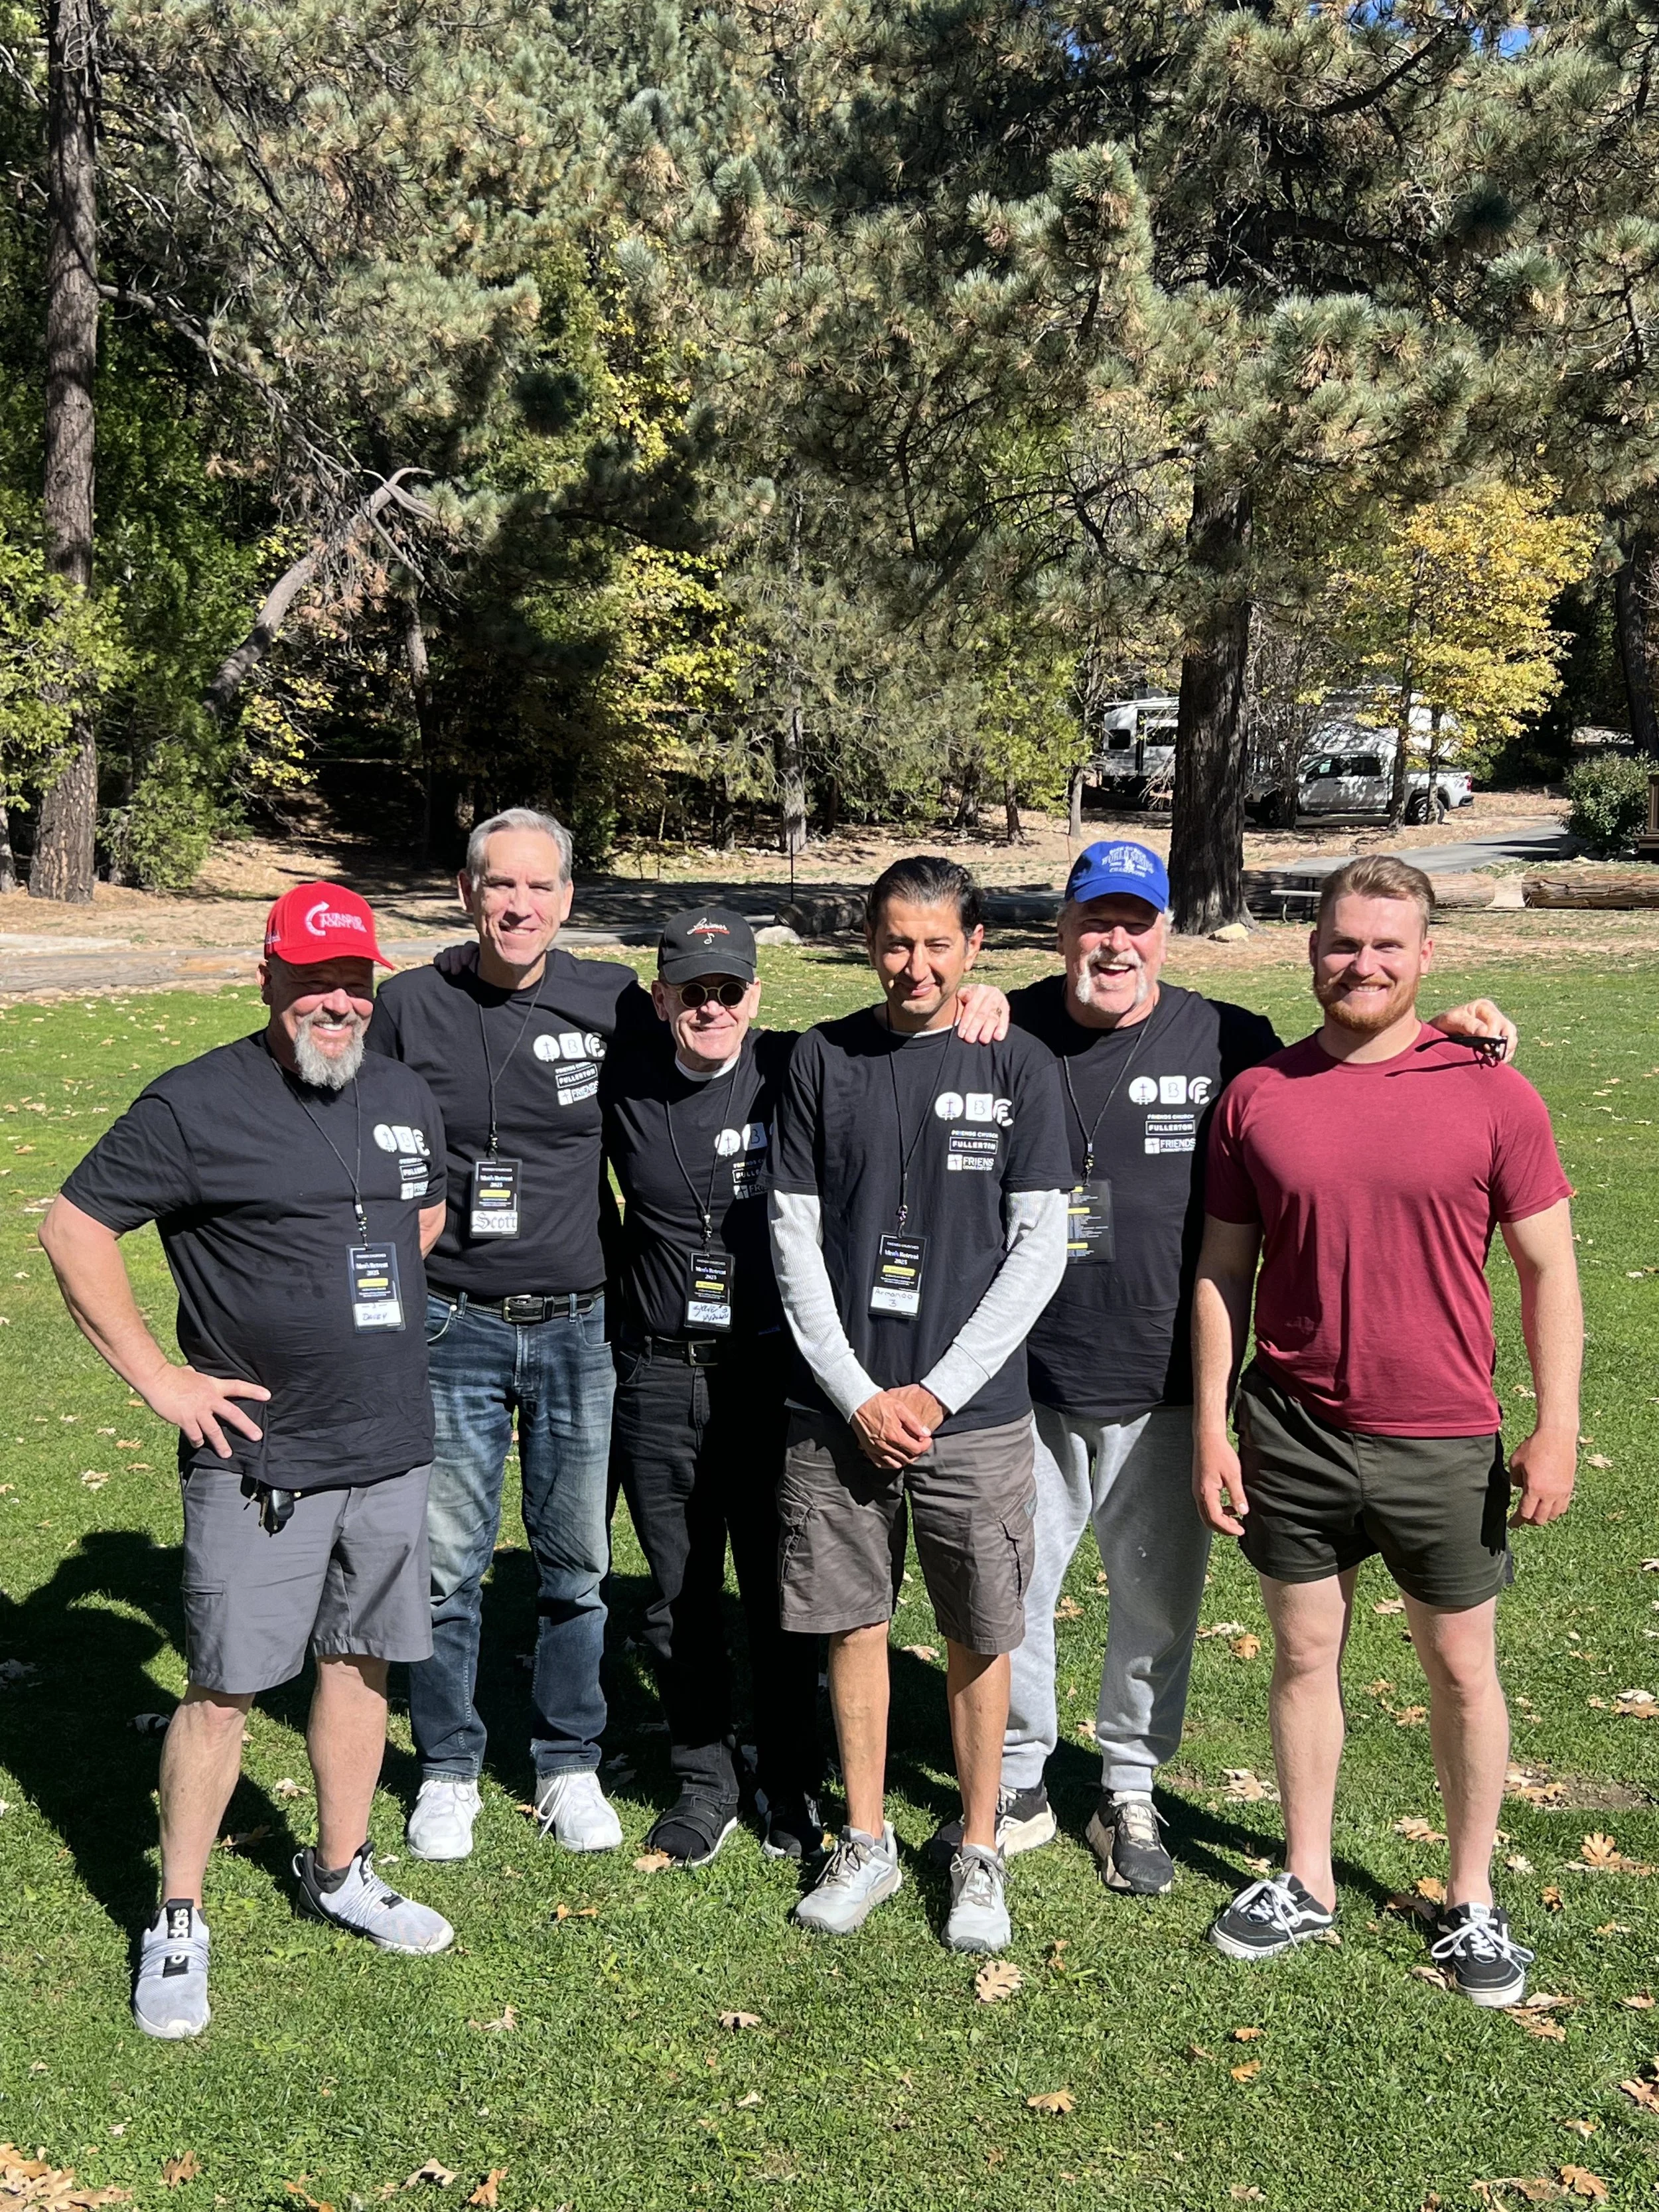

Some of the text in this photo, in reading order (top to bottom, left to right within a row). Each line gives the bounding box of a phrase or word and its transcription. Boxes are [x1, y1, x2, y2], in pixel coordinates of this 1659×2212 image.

[558, 1067, 597, 1084] FULLERTON
[1148, 1123, 1193, 1132] FULLERTON
[1159, 1138, 1196, 1149] FRIENDS
[962, 1155, 995, 1167] FRIENS
[472, 1212, 516, 1230] Scott
